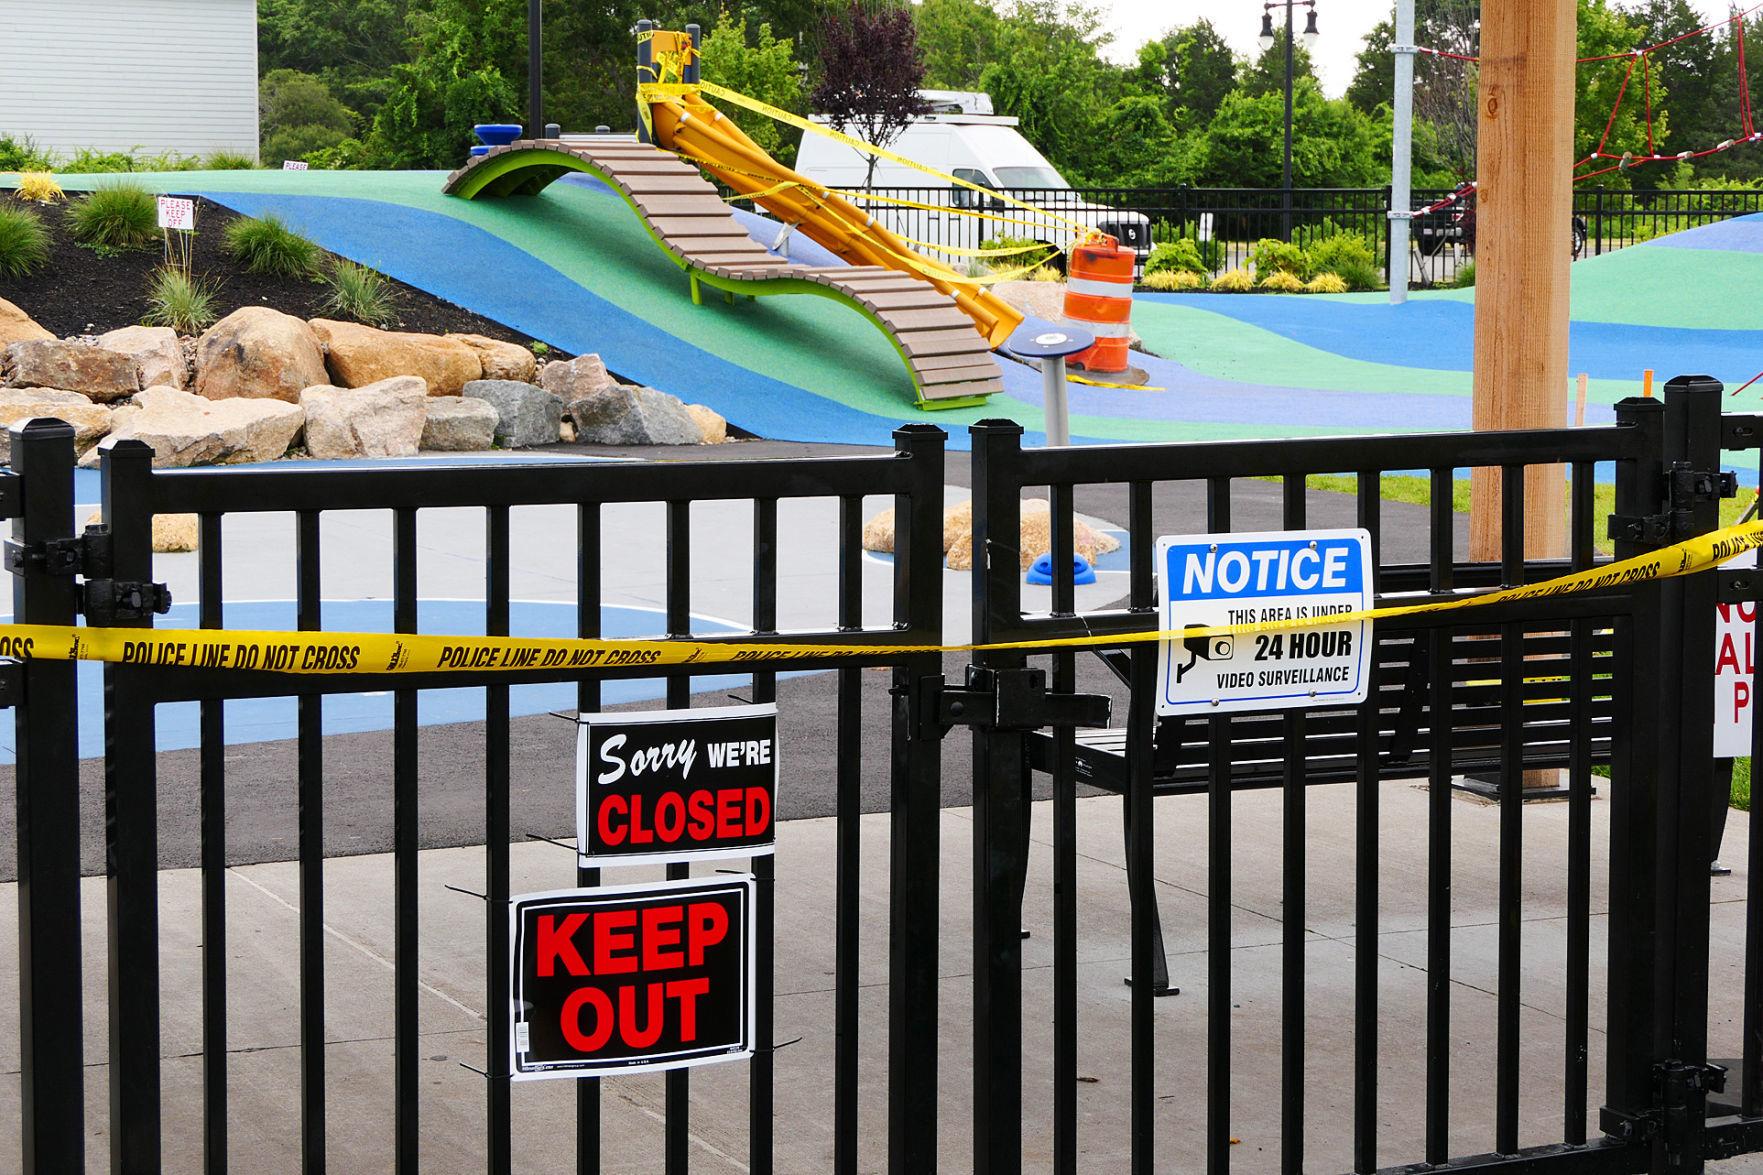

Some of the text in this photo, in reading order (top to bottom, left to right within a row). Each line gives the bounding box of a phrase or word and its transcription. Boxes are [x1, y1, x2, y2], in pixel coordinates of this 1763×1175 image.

[160, 199, 191, 210] PLEASE
[165, 209, 186, 219] KEEP
[168, 218, 182, 228] OFF
[1183, 547, 1349, 594] NOTICE
[1593, 571, 1621, 590] NOT
[1620, 561, 1661, 584] CROSS
[1228, 603, 1353, 626] THIS AREA IS UNDER
[122, 641, 187, 664] POLICE
[190, 643, 231, 668] LINE
[232, 644, 259, 670] DO
[262, 645, 300, 670] NOT
[301, 645, 361, 670] CROSS
[437, 646, 501, 668] POLICE
[500, 647, 541, 667] LINE
[540, 648, 567, 667] DO
[567, 648, 606, 666] NOT
[603, 649, 662, 665] CROSS
[1254, 630, 1353, 661] 24 HOUR
[1217, 666, 1350, 689] VIDEO SURVEILLANCE
[598, 734, 771, 785] Sorry WE'RE
[598, 786, 771, 846] CLOSED
[537, 902, 729, 977] KEEP
[560, 977, 710, 1053] OUT
